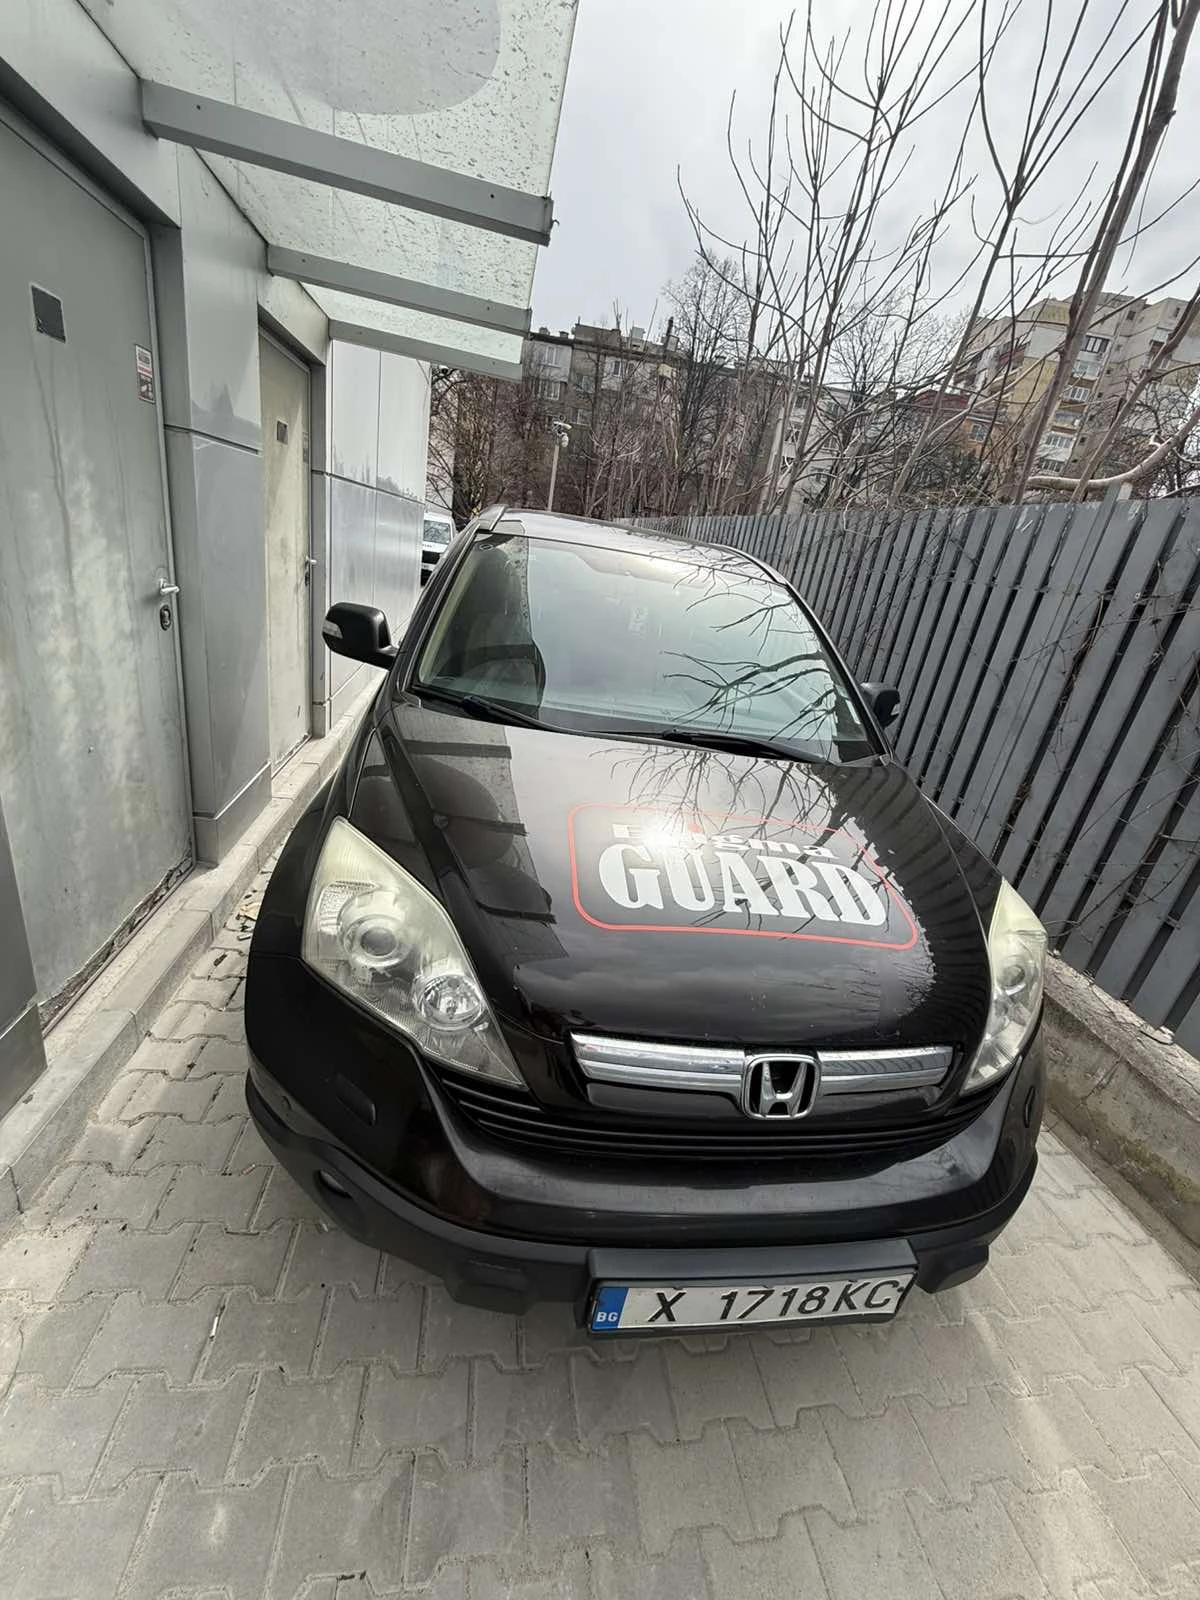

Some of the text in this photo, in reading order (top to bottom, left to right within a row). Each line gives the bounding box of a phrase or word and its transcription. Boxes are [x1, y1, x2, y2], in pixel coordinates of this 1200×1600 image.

[599, 843, 887, 926] GUARD
[595, 1311, 618, 1323] BG
[647, 1291, 686, 1322] X
